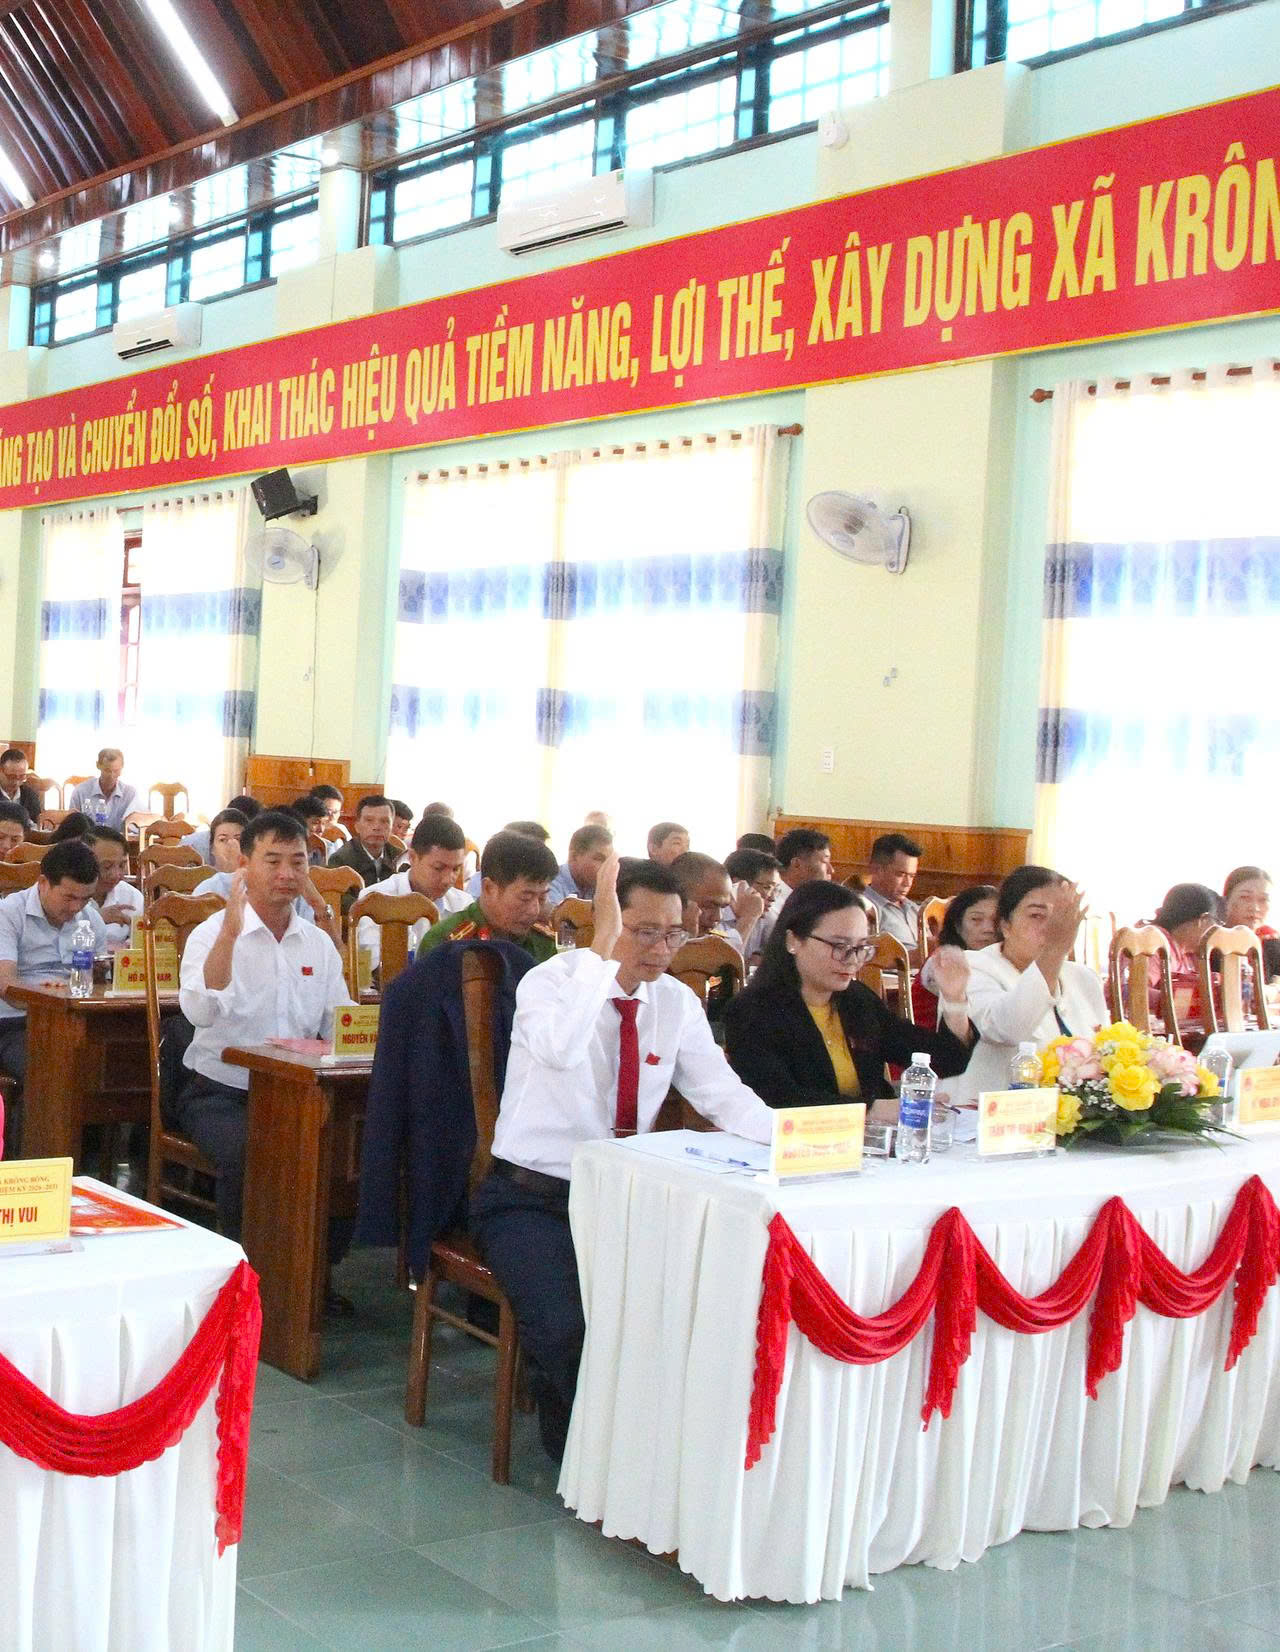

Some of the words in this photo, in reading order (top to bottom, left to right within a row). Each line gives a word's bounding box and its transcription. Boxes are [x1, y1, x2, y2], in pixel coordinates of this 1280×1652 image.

[27, 428, 54, 495] TẠO
[58, 413, 77, 480] VÀ
[81, 388, 148, 476] CHUYỂN
[150, 379, 182, 464] ĐỔI
[186, 373, 217, 462] SỐ,
[223, 382, 272, 452] KHAI
[279, 357, 335, 441] THÁC
[341, 343, 398, 441] HIỆU
[404, 316, 456, 425] QUẢ
[466, 304, 535, 407] TIỀM
[541, 295, 640, 388] NĂNG,
[650, 277, 706, 388] LỢI
[718, 236, 795, 362] THẾ,
[807, 231, 893, 345] XÂY
[903, 213, 1034, 343] DỰNG
[1047, 172, 1116, 303] XÃ
[18, 1207, 38, 1223] VUI
